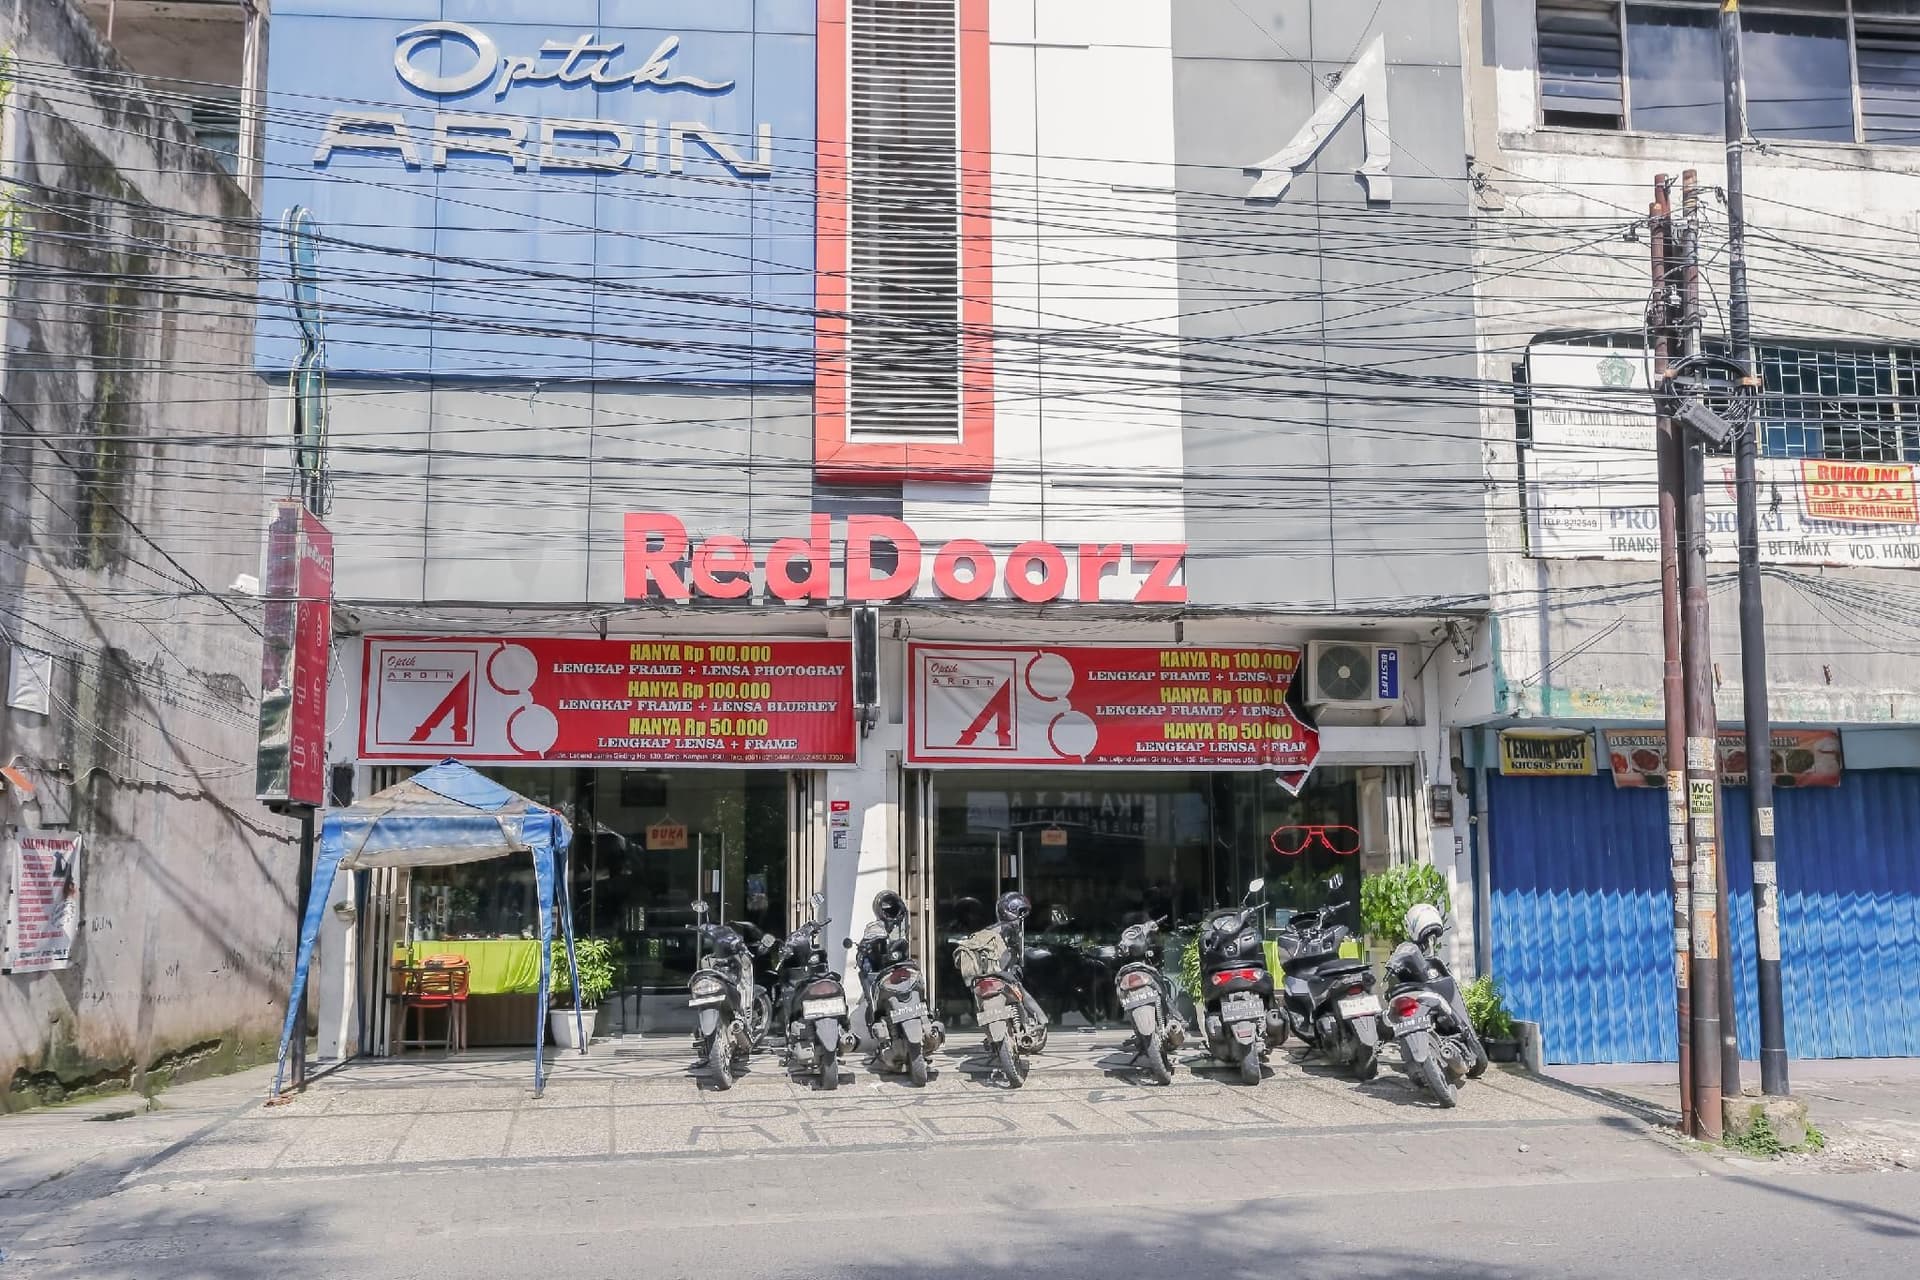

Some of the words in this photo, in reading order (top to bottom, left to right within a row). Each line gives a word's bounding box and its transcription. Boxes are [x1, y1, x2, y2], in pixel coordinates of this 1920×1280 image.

[394, 21, 735, 102] Optik
[313, 110, 771, 178] ARDIN
[1817, 465, 1870, 481] RUKO
[1875, 468, 1900, 482] INI
[1813, 484, 1910, 501] DIJUAL
[623, 512, 1189, 602] RedDoorz
[1769, 541, 1831, 557] BETAMAX
[630, 644, 680, 662] HANYA
[684, 644, 705, 664] Rp
[708, 645, 771, 662] 100.000
[1160, 651, 1207, 668] HANYA
[1211, 652, 1229, 670] Rp
[1233, 652, 1292, 670] 100.000
[387, 671, 454, 680] ARDIN
[553, 664, 625, 674] LENGKAP
[629, 664, 682, 675] FRAME
[702, 665, 750, 676] LENSA
[754, 665, 845, 676] PHOTOGRAY
[1088, 671, 1156, 682] LENGKAP
[1160, 671, 1210, 682] FRAME
[1229, 672, 1273, 683] LENSA
[932, 677, 994, 687] ARDIN
[628, 681, 680, 699] HANYA
[682, 682, 704, 700] Rp
[706, 682, 770, 699] 100.000
[1160, 687, 1209, 704] HANYA
[1213, 688, 1232, 706] Rp
[559, 700, 633, 711] LENGKAP
[637, 700, 693, 712] FRAME
[712, 701, 762, 713] LENSA
[1096, 705, 1166, 716] LENGKAP
[1171, 706, 1222, 717] FRAME
[1242, 706, 1286, 717] LENSA
[629, 717, 680, 736] HANYA
[685, 718, 706, 737] Rp
[710, 718, 769, 736] 50.000
[1164, 722, 1214, 740] HANYA
[1216, 723, 1238, 742] Rp
[1240, 722, 1293, 741] 50.000
[598, 737, 671, 749] LENGKAP
[675, 738, 725, 749] LENSA
[744, 738, 798, 750] FRAME
[1136, 742, 1206, 753] LENGKAP
[1209, 742, 1256, 753] LENSA
[1504, 738, 1552, 759] TERIMA
[1555, 737, 1586, 760] KOST
[1512, 761, 1552, 770] KHUSUS
[1555, 762, 1583, 770] PUTRI
[1692, 783, 1712, 793] WC
[652, 828, 683, 840] BUKA
